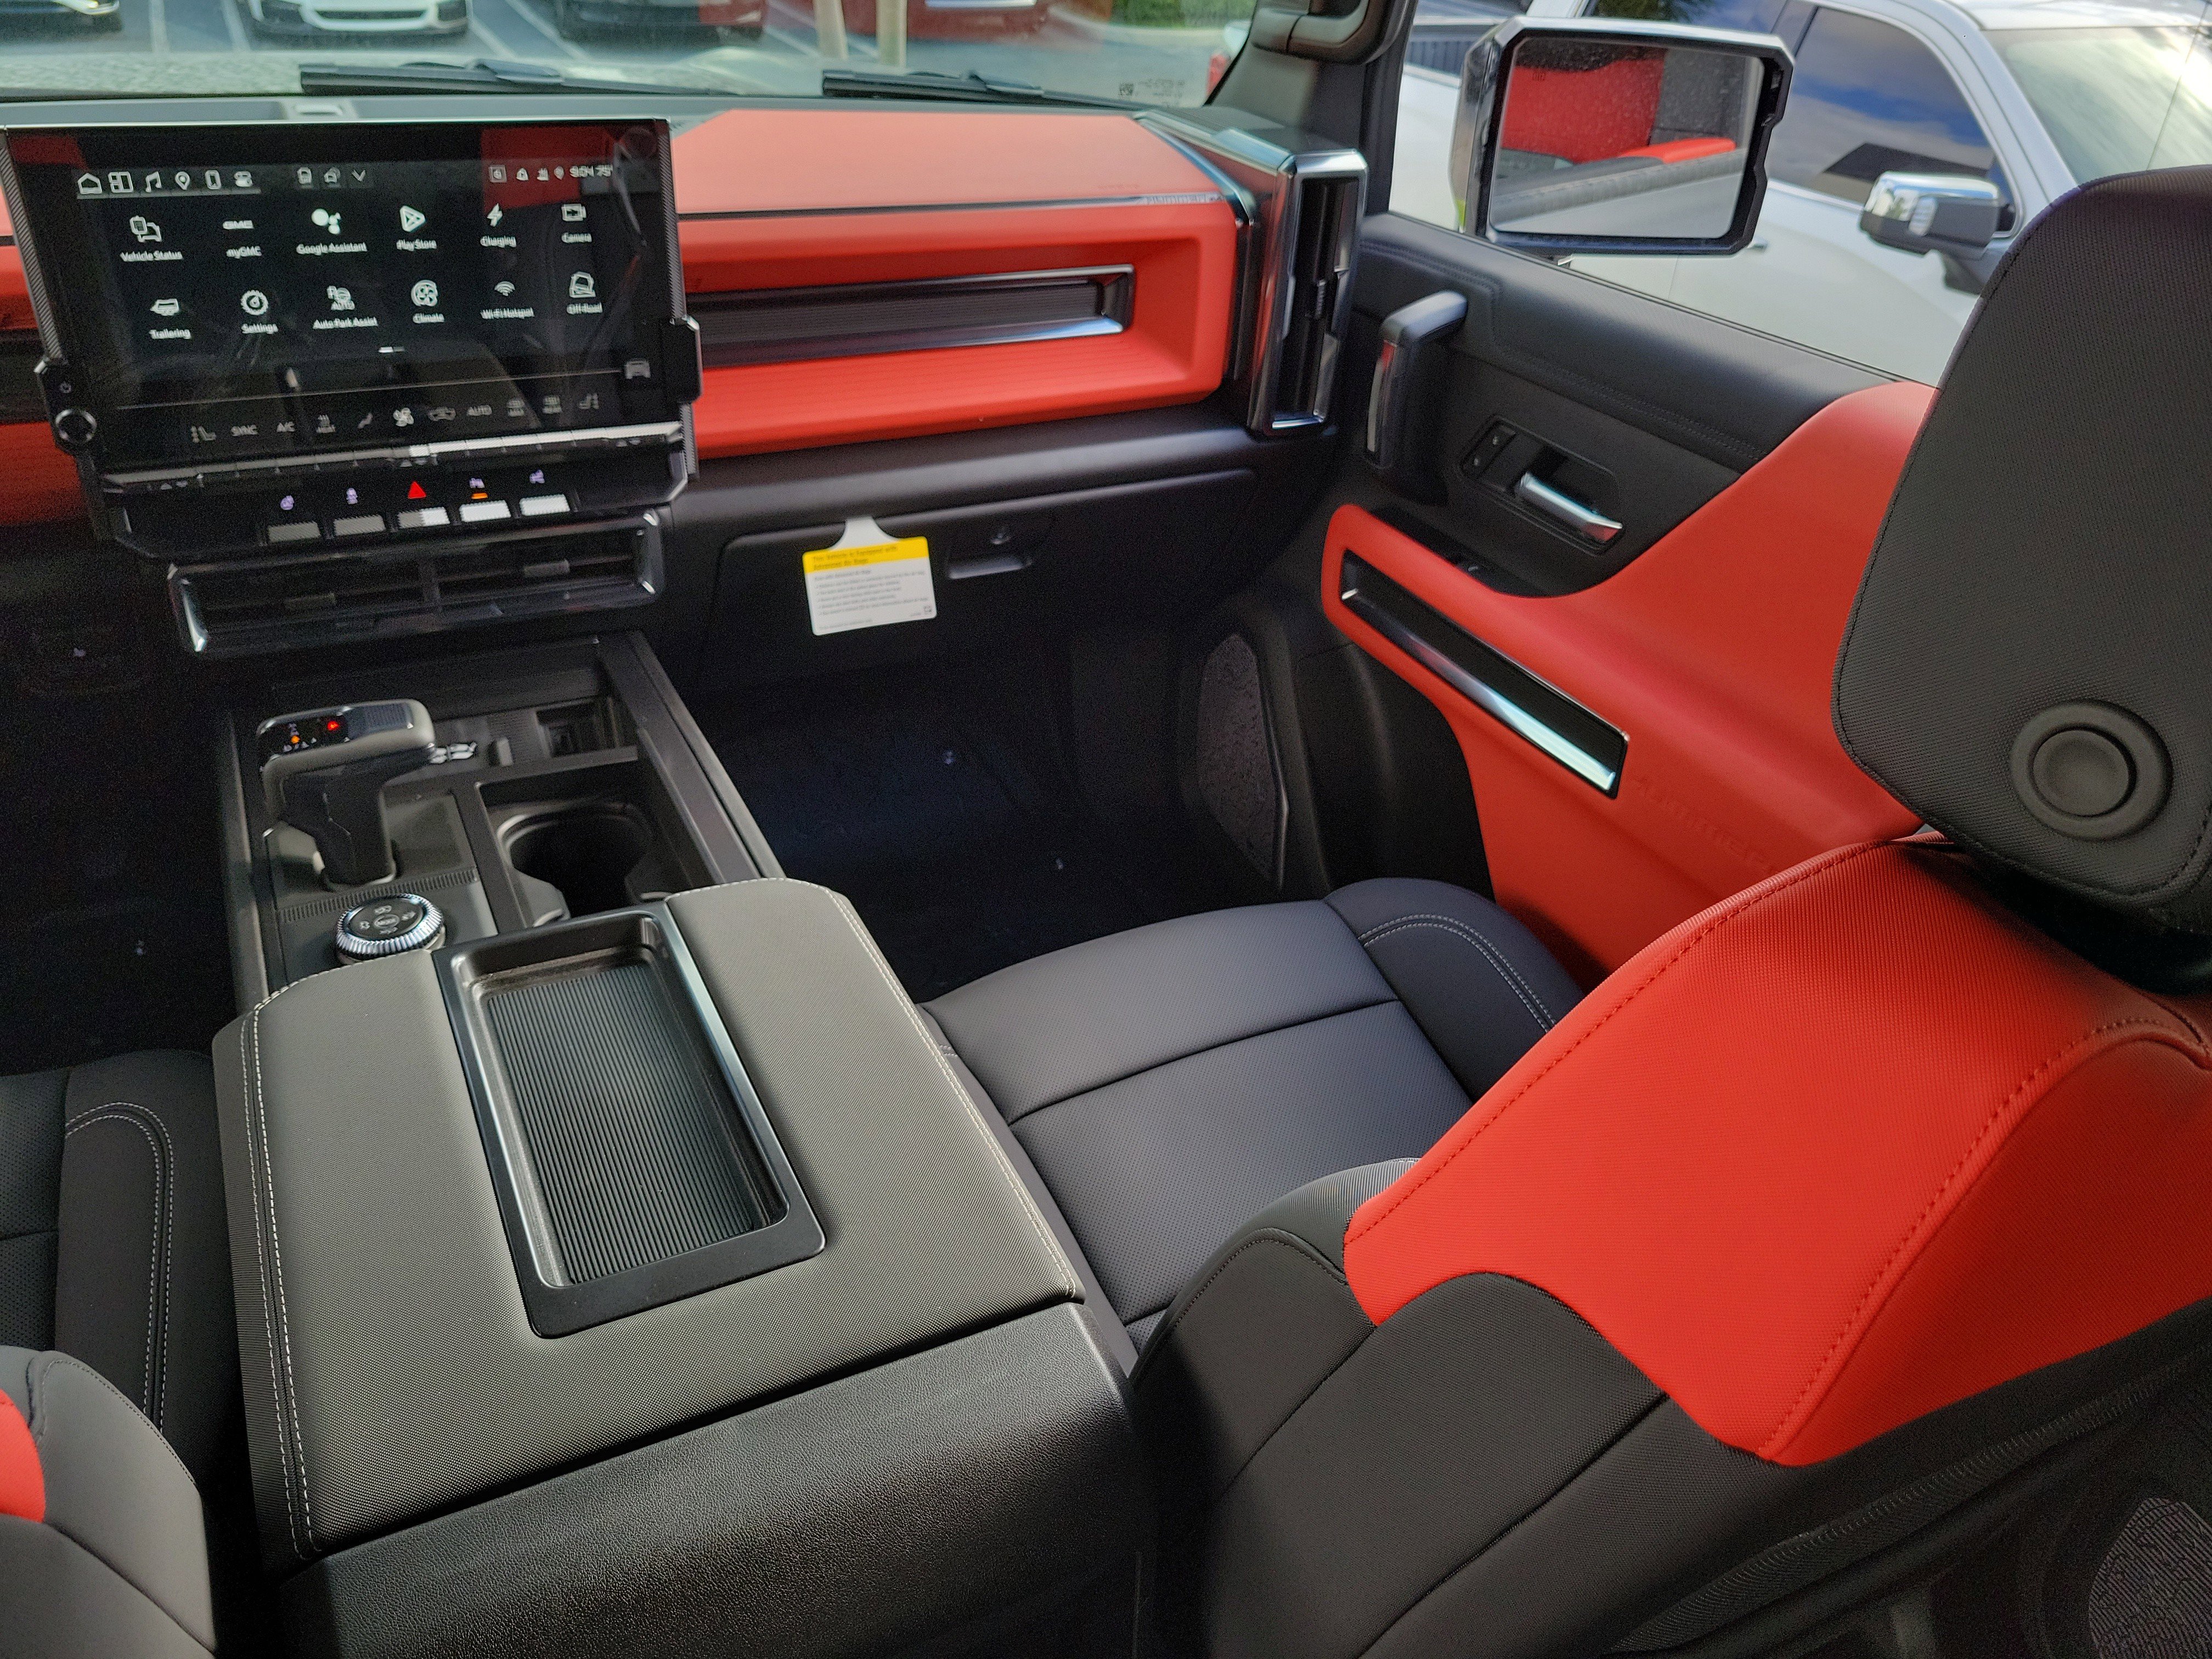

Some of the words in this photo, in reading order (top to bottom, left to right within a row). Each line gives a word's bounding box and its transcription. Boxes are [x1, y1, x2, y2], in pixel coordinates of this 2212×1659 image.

[481, 235, 516, 247] Charging
[562, 233, 591, 243] Camera
[296, 244, 328, 255] Google
[328, 242, 367, 252] Assistant
[397, 240, 415, 251] Play
[415, 239, 437, 249] Store
[120, 251, 154, 262] Vehicle
[154, 250, 183, 261] Status
[227, 246, 262, 258] myGMC
[413, 313, 444, 323] Climate
[504, 307, 534, 319] Hotspot
[241, 323, 278, 334] Settings
[313, 319, 334, 329] Auto
[334, 318, 353, 328] Park
[354, 317, 378, 326] Assist
[149, 329, 191, 339] Trailering
[467, 405, 492, 416] AUTO
[231, 425, 258, 437] SYNC
